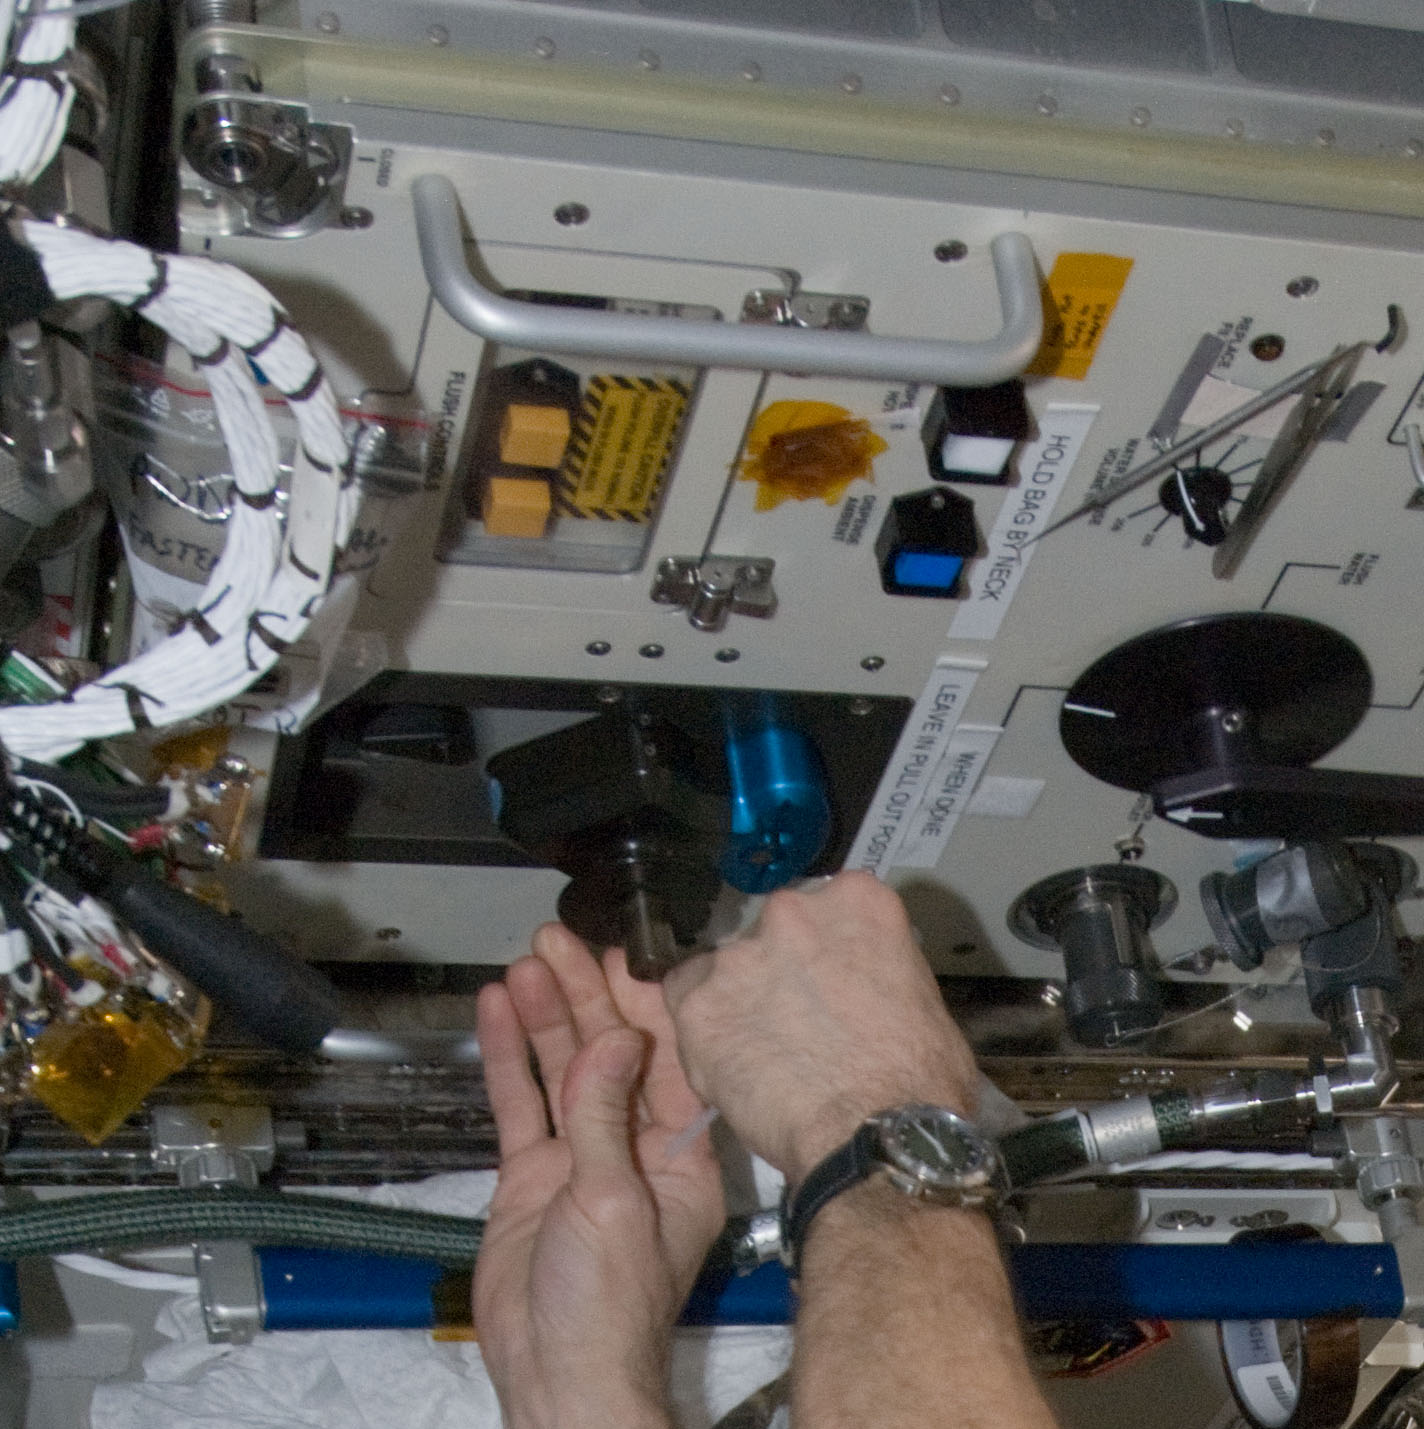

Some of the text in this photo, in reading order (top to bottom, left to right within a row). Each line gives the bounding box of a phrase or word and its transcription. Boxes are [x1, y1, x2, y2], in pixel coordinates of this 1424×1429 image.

[981, 434, 1071, 602] HOLD BAG BY NECK
[922, 684, 960, 733] LEAVE
[914, 735, 937, 750] IN
[896, 754, 929, 788] PULL
[944, 751, 978, 795] WHEN
[885, 792, 911, 821] OUT
[920, 798, 955, 837] DONE
